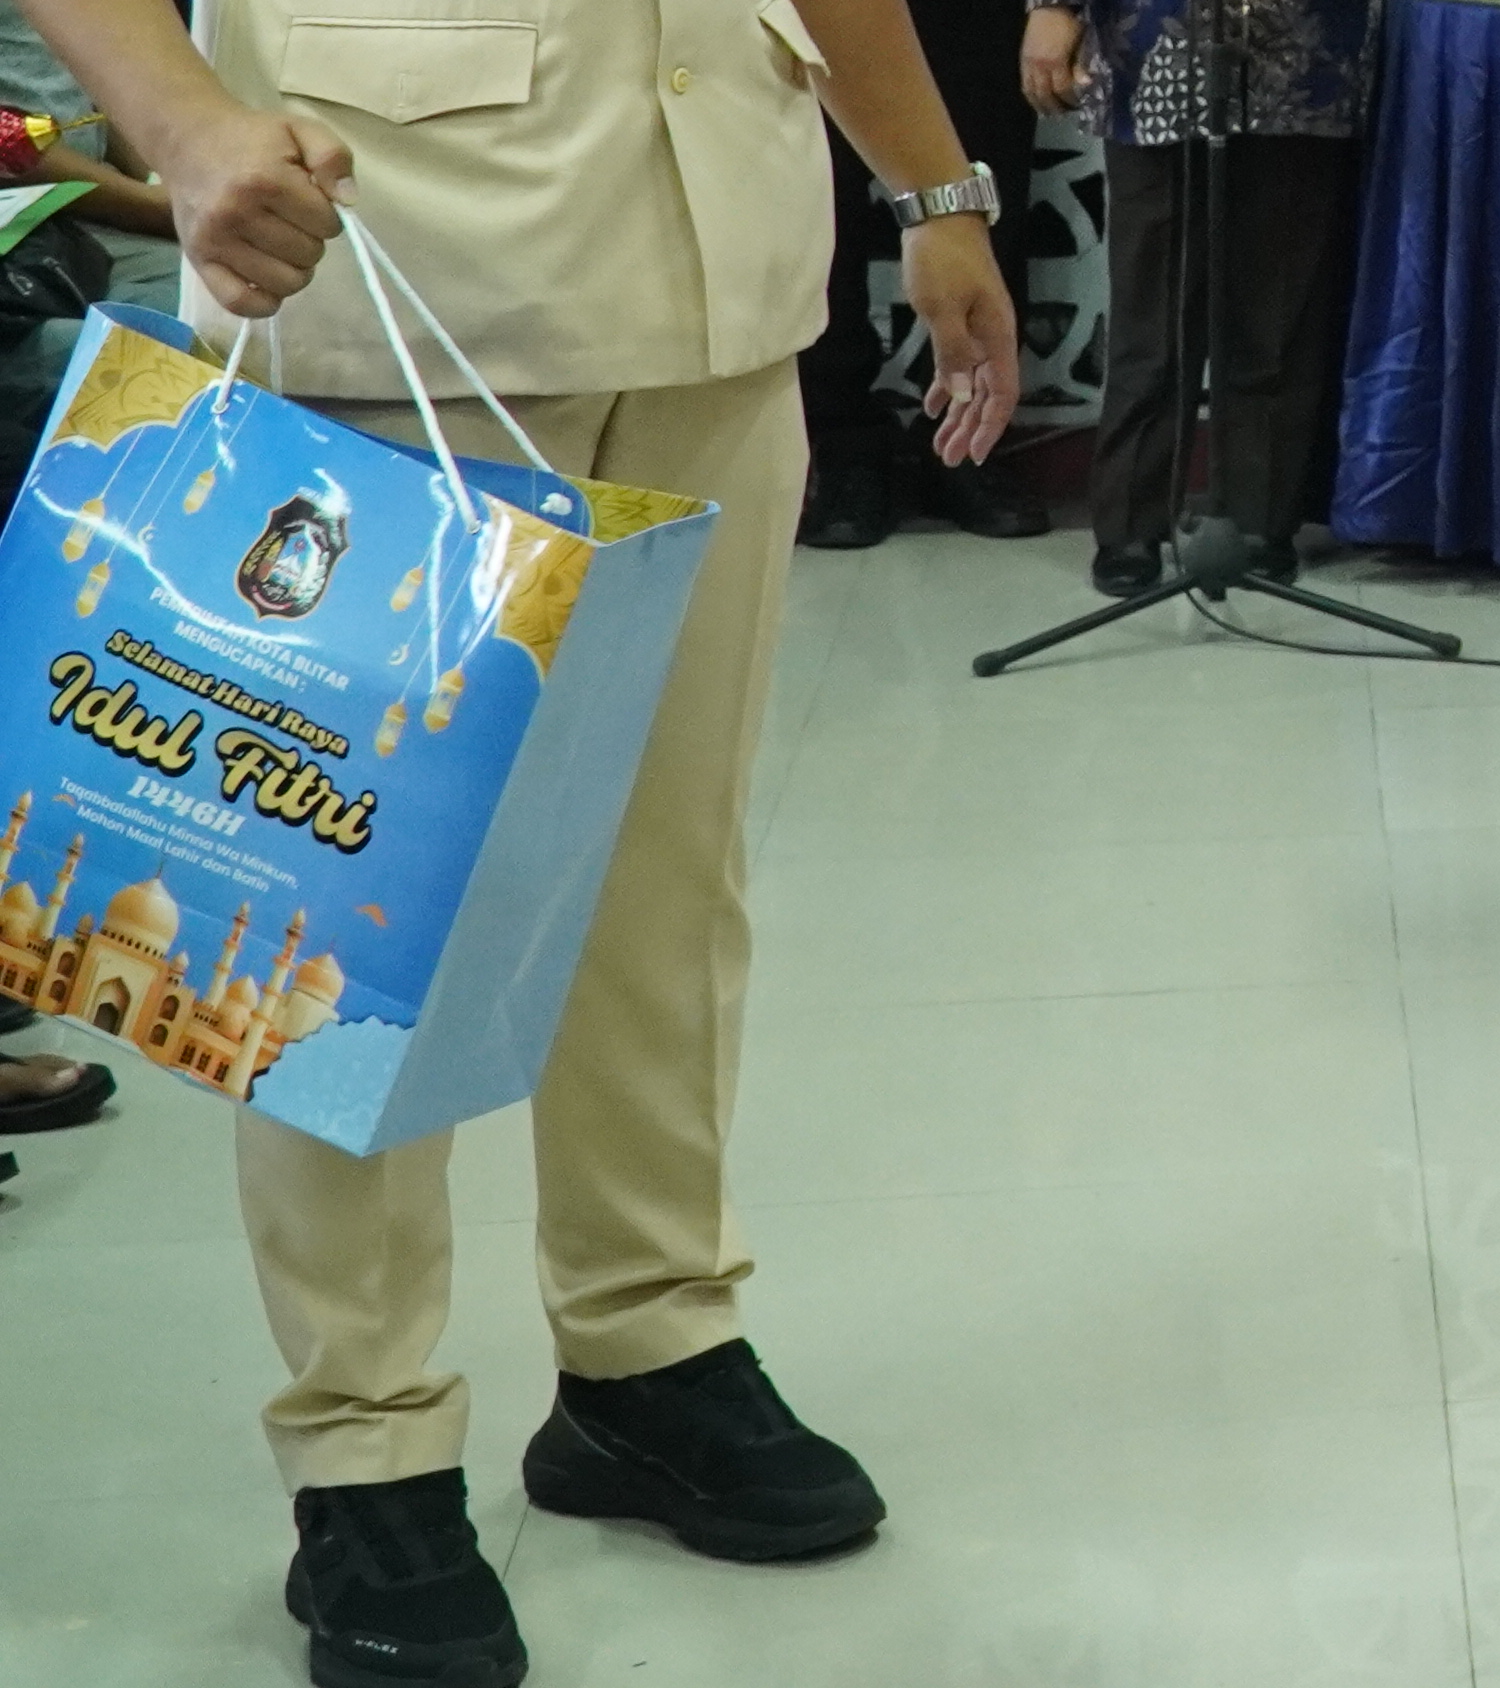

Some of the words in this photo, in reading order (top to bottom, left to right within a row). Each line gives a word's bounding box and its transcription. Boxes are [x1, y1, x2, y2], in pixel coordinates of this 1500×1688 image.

[105, 628, 218, 700] Selamat
[210, 677, 285, 728] Hari
[277, 707, 350, 759] Raya
[292, 655, 350, 692] BLITAR
[49, 650, 204, 777] Idul
[214, 726, 377, 855] Fitri
[76, 804, 125, 835] Mohon
[127, 775, 246, 837] 1446H
[216, 842, 242, 862] Wa
